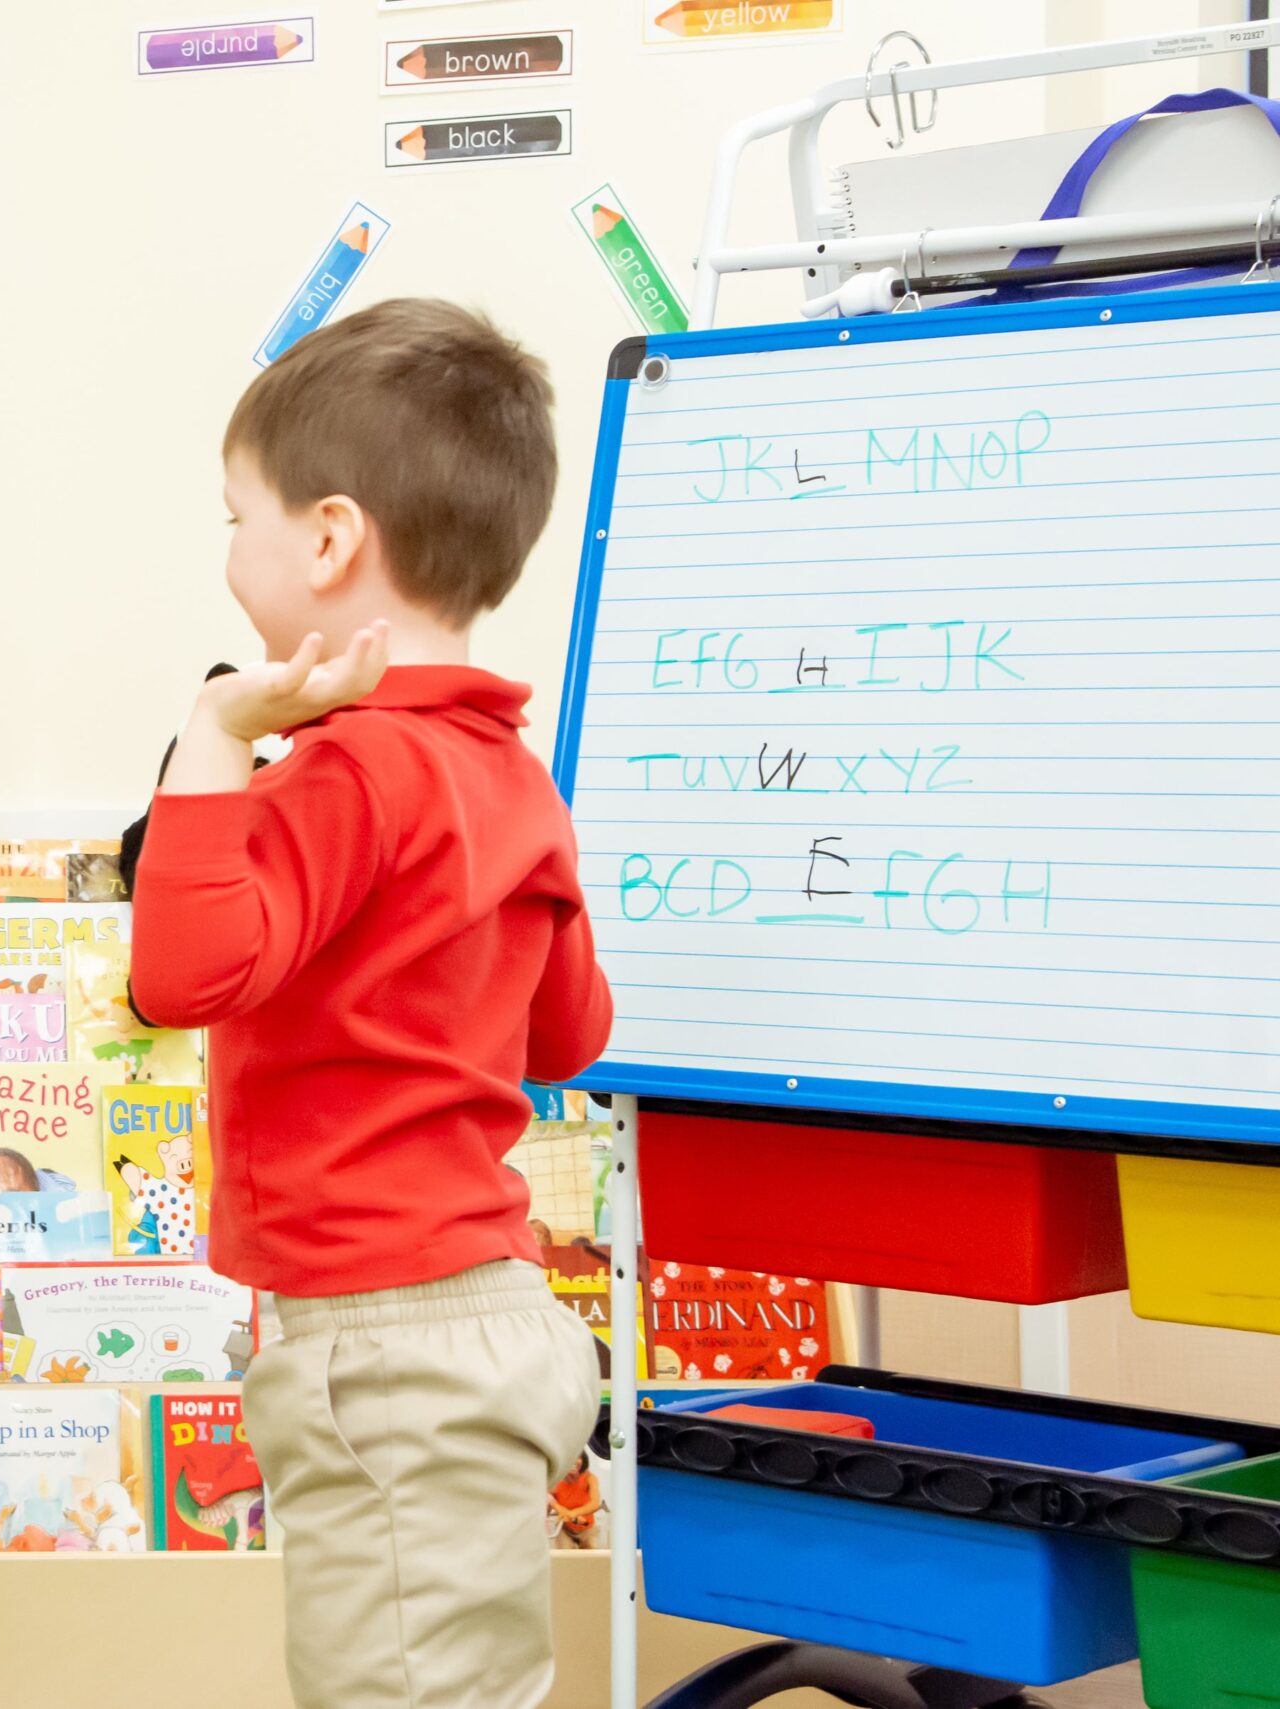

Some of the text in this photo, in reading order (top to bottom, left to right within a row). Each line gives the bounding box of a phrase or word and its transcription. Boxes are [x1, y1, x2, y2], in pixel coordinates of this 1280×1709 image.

[701, 1, 791, 33] yellow
[181, 28, 259, 62] purple
[445, 50, 530, 74] brown
[447, 124, 517, 150] black
[298, 271, 342, 321] blue
[611, 247, 668, 319] green
[38, 952, 63, 966] ME
[109, 1099, 161, 1135] GET
[24, 1274, 231, 1301] Gregory, the Terrible Eater
[171, 1401, 237, 1416] HOW IT
[19, 1420, 37, 1439] in
[44, 1425, 55, 1439] a
[61, 1419, 110, 1443] Shop
